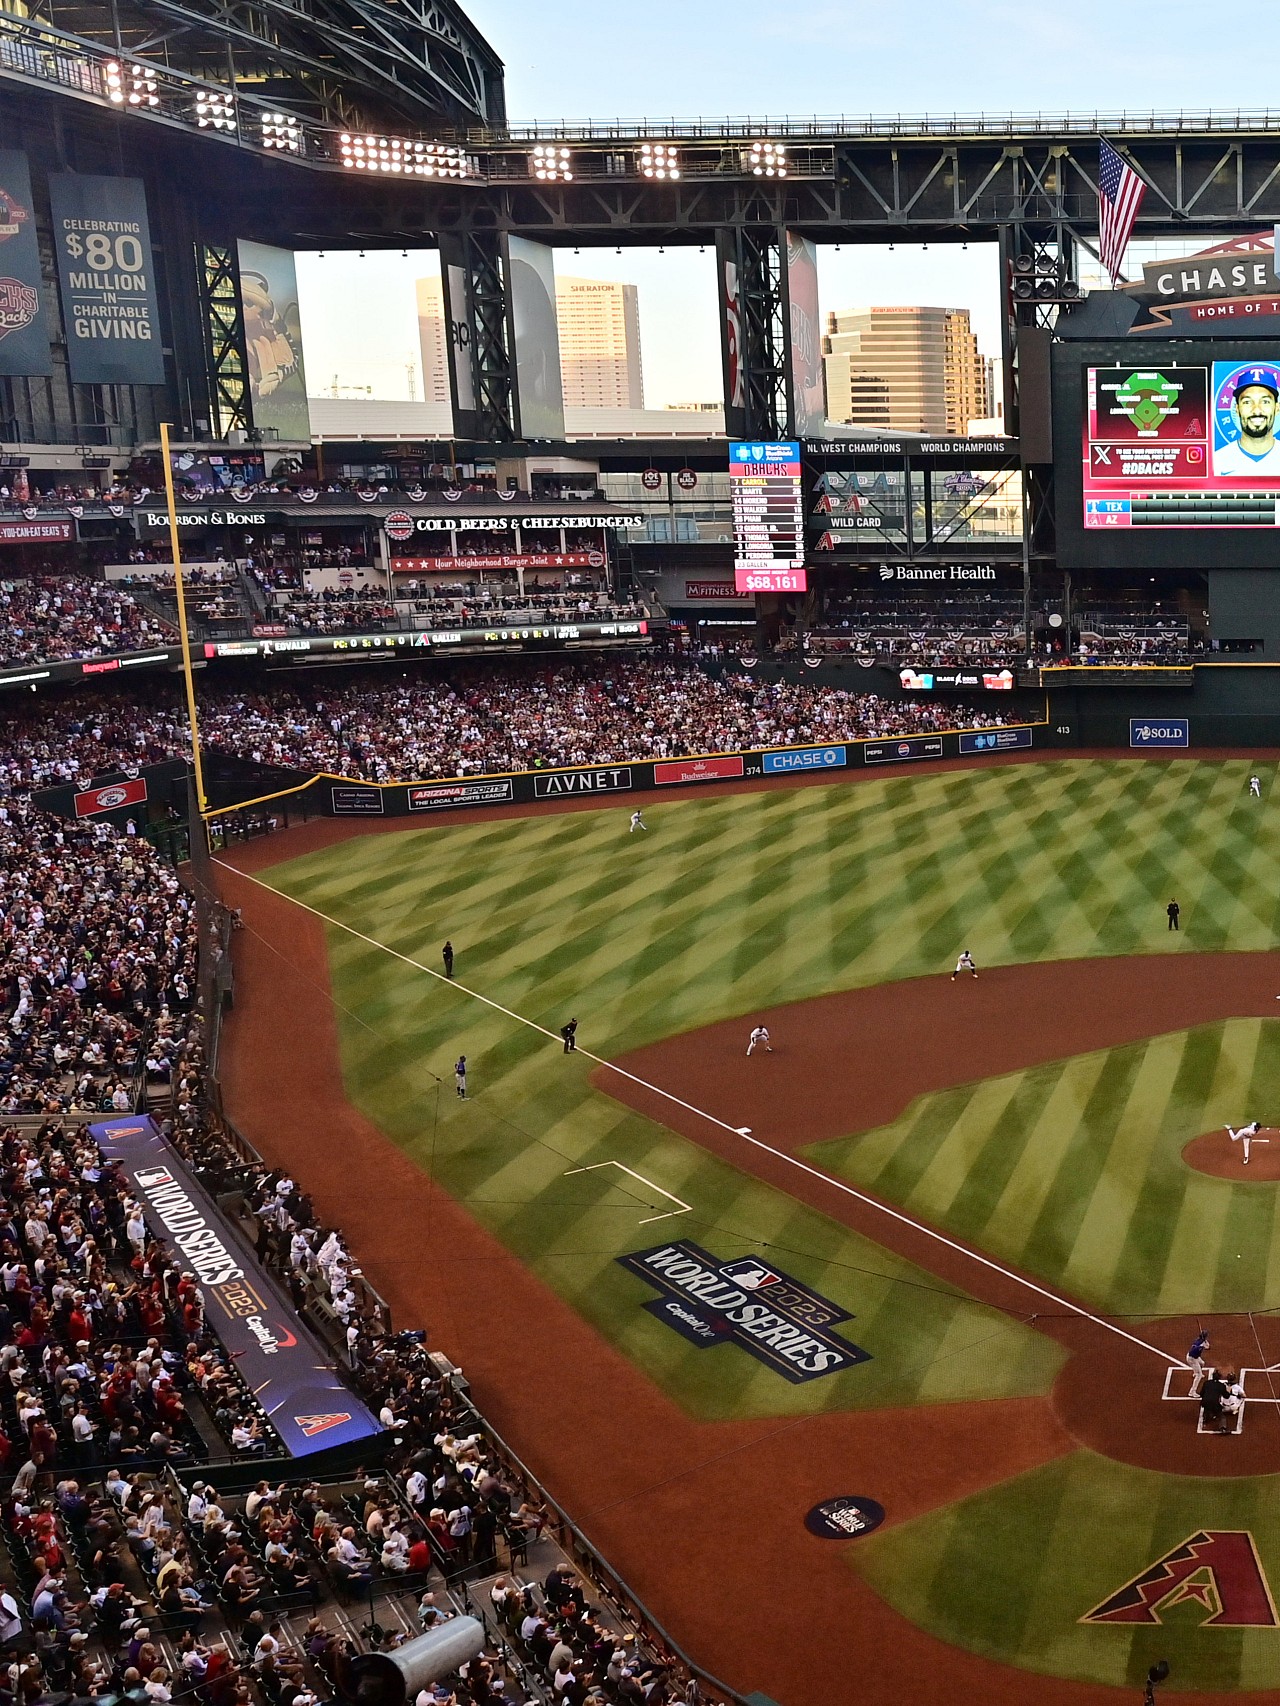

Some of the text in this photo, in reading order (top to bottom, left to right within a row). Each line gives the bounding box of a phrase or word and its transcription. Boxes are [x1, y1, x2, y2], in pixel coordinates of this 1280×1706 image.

[63, 219, 140, 233] CELEBRATING
[65, 232, 143, 272] $80
[69, 272, 146, 291] MILLION
[1157, 263, 1267, 296] CHASE
[103, 292, 117, 304] IN
[73, 304, 149, 319] CHARITABLE
[1197, 303, 1235, 318] HOME
[1244, 303, 1262, 314] OF
[75, 319, 151, 340] GIVING
[807, 443, 901, 453] NL WEST CHAMPIONS
[920, 443, 1005, 453] WORLD CHAMPIONS
[1122, 463, 1174, 475] #DBACKS
[829, 477, 838, 485] 99
[858, 477, 867, 485] 01
[887, 477, 895, 485] 02
[1105, 502, 1123, 511] TEX
[147, 511, 266, 527] BOURBON & BONES
[416, 518, 457, 532] COLD
[460, 517, 508, 531] BEERS
[511, 519, 520, 530] &
[522, 516, 643, 530] CHEESEBURGERS
[831, 517, 881, 527] WILD CARD
[1106, 514, 1118, 524] AZ
[42, 526, 60, 537] SEATS
[434, 554, 549, 569] Your Neighborhood Burger Joint
[896, 565, 996, 580] Banner Health
[746, 576, 797, 591] $68,161
[700, 588, 735, 596] FITNESS
[274, 640, 347, 650] EOVALDI PC:
[432, 632, 499, 644] GALLEN PC:
[82, 659, 118, 673] Honeywell
[1056, 726, 1071, 734] 413
[773, 753, 822, 768] CHASE
[681, 769, 719, 780] Budweiser
[746, 766, 761, 776] 374
[546, 770, 622, 794] AVNET
[415, 783, 509, 799] ARIZONA SPORTS
[453, 795, 479, 803] SPORTS
[479, 792, 507, 800] LEADER
[144, 1180, 204, 1234] WORLD
[175, 1228, 245, 1286] SERIES
[219, 1282, 257, 1317] 2023
[644, 1247, 844, 1372] WORLD SERIES
[762, 1285, 831, 1325] 2023
[828, 1512, 855, 1533] SERIES
[838, 1508, 865, 1529] WORLD
